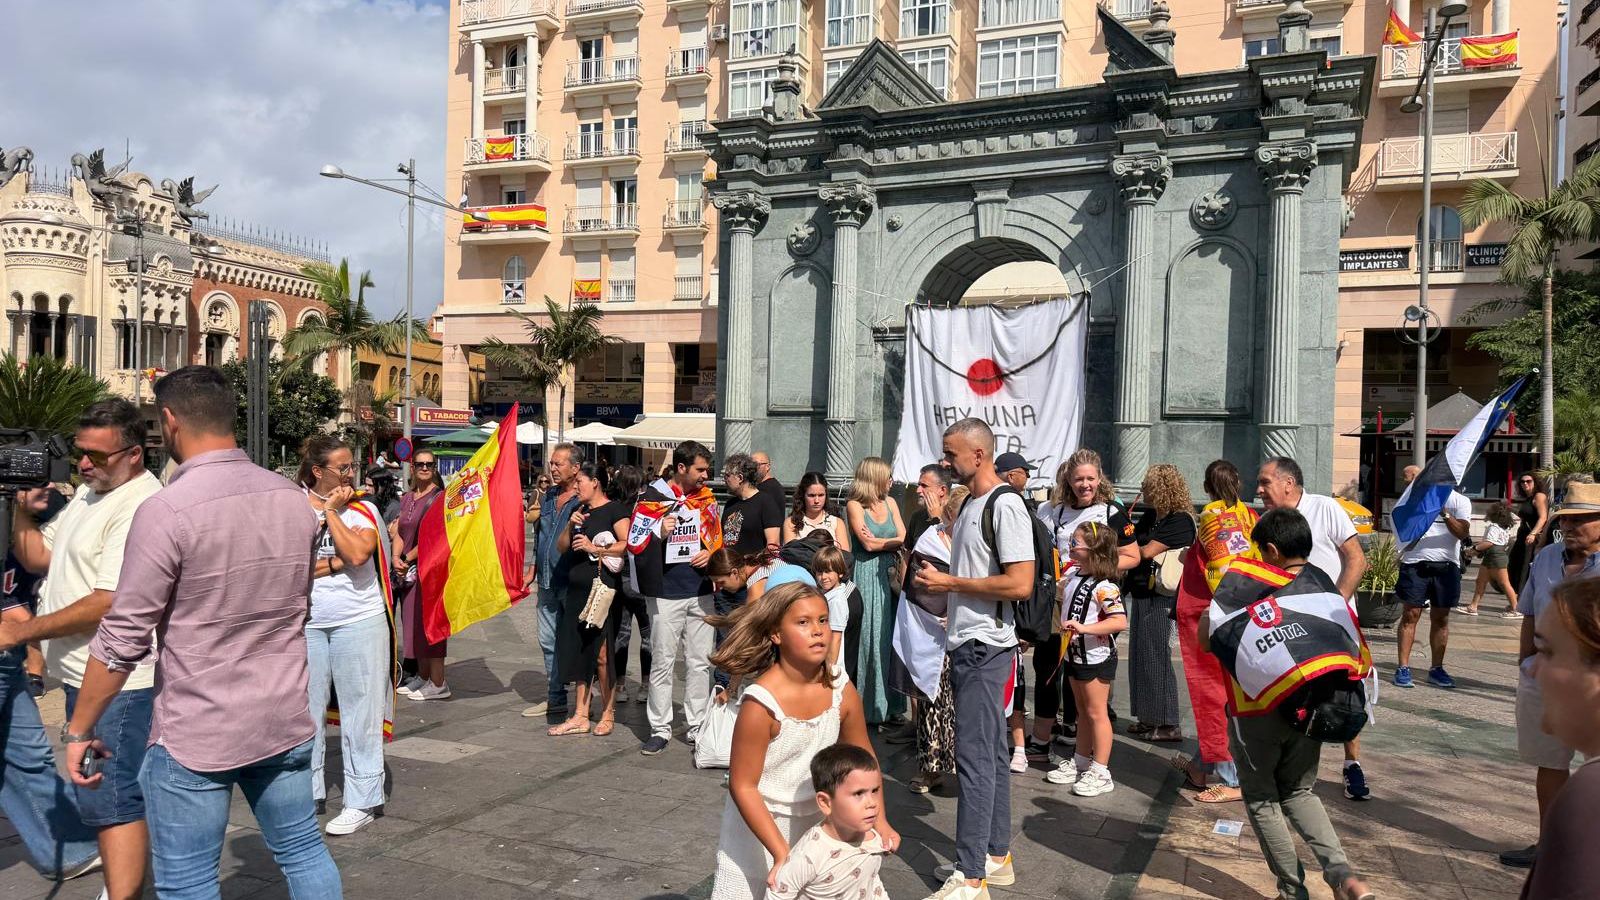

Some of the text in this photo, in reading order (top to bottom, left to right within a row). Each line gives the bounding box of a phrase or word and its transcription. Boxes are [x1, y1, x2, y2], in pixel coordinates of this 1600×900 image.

[1339, 251, 1403, 261] ORTODONCIA
[1479, 256, 1496, 265] 956
[1343, 260, 1399, 270] IMPLANTES
[596, 406, 620, 416] BBVA
[933, 404, 1037, 427] HAY UNA
[433, 412, 469, 421] TABACOS
[672, 524, 697, 535] CEUTA
[1255, 622, 1309, 654] CEUTA
